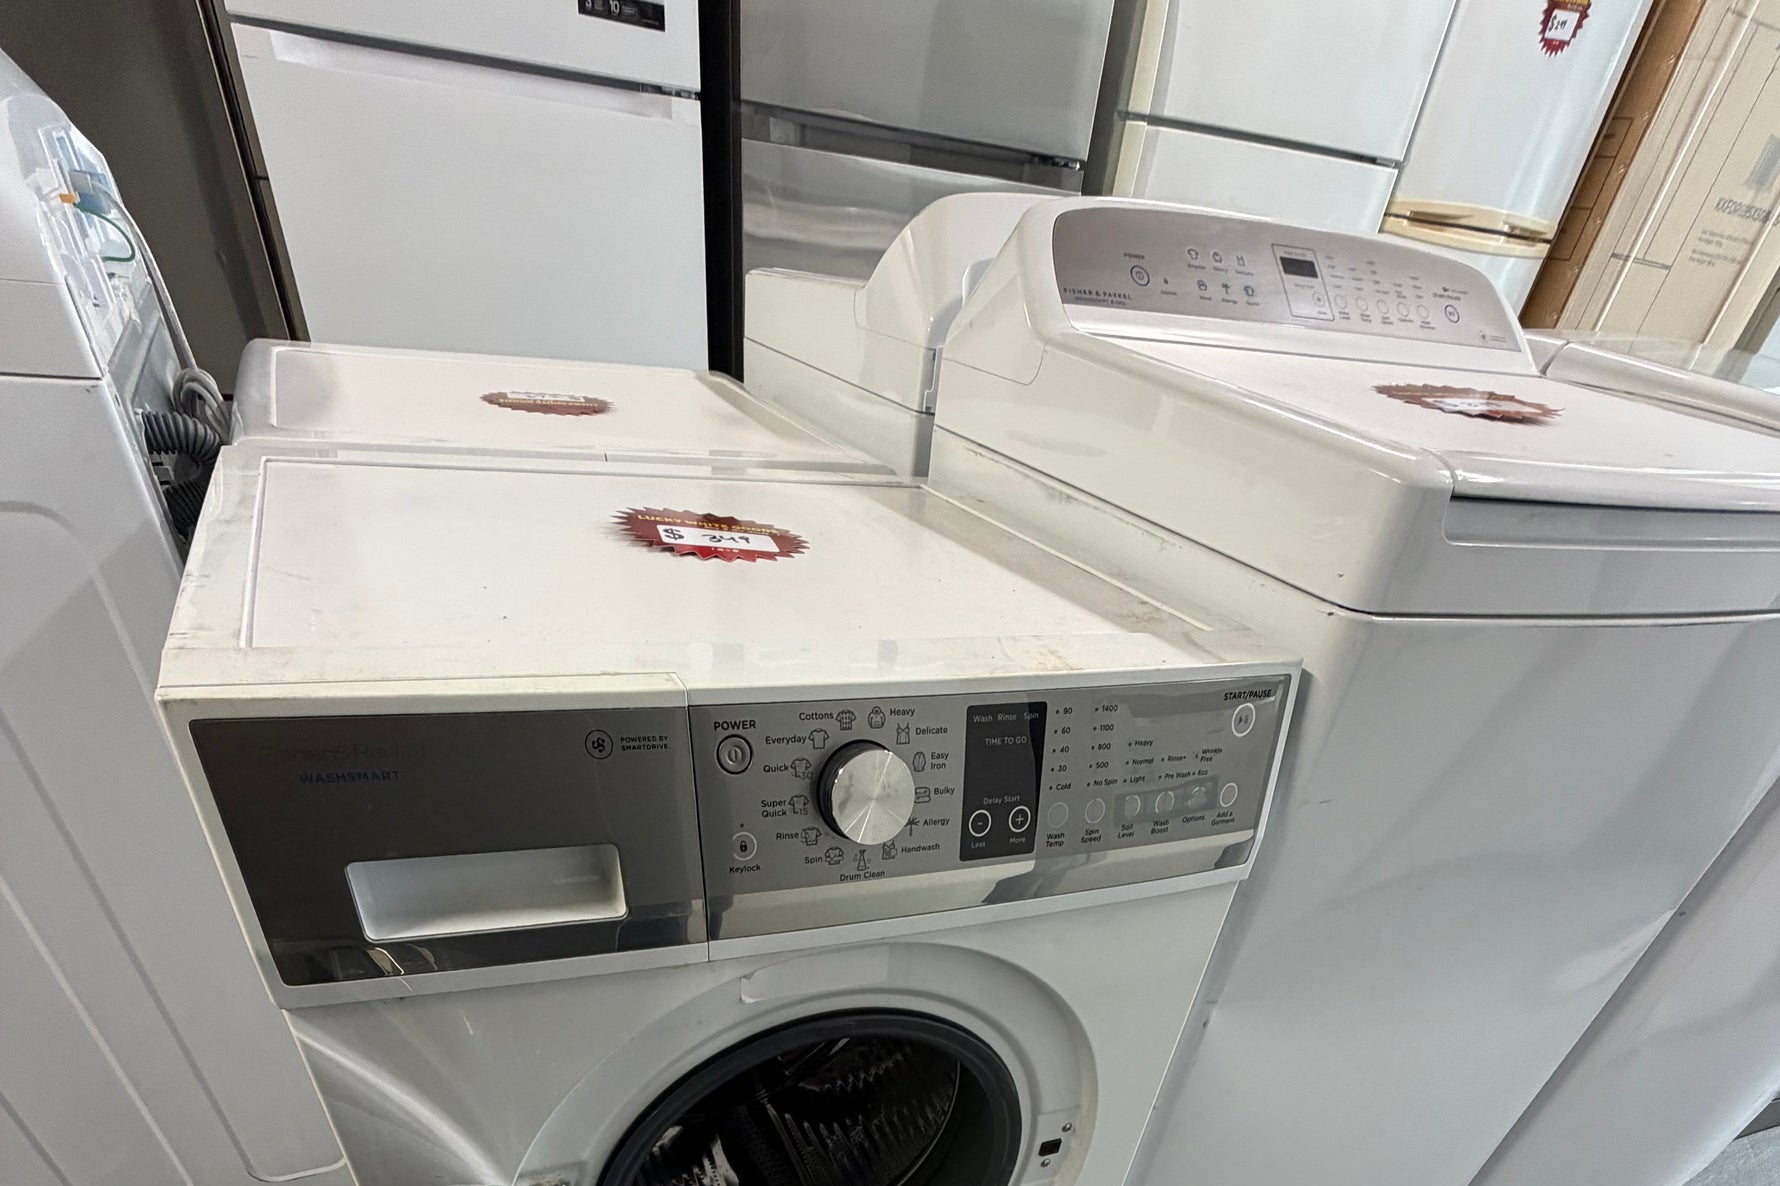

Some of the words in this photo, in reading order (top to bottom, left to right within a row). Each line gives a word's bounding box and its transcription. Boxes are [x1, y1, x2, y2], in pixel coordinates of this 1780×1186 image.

[638, 514, 681, 523] LUCKY
[663, 528, 684, 540] $
[1224, 690, 1272, 700] START/PAUSE
[799, 712, 834, 721] Cottons
[890, 708, 915, 717] Heavy
[973, 714, 992, 723] Wash
[998, 713, 1017, 722] Rinse
[1024, 712, 1039, 720] Spin
[714, 720, 756, 730] POWER
[915, 726, 948, 735] Delicate
[766, 735, 806, 745] Everyday
[985, 737, 1001, 746] TIME
[1004, 736, 1014, 745] TO
[1016, 736, 1027, 744] GO
[931, 752, 949, 762] Easy
[763, 764, 790, 773] Quick
[931, 762, 946, 770] Iron
[297, 770, 400, 784] WASHSMART
[934, 786, 955, 796] Bulky
[761, 800, 786, 808] Super
[983, 796, 1001, 805] Delay
[1004, 795, 1020, 803] Start
[762, 809, 787, 818] Quick
[922, 817, 950, 827] Allergy
[1182, 815, 1204, 823] Options
[1211, 817, 1235, 826] Garment
[1047, 832, 1065, 840] Wash
[1080, 835, 1101, 844] Speed
[901, 843, 940, 854] Handwash
[804, 856, 823, 864] Spin
[729, 864, 761, 873] Keylock
[840, 873, 862, 882] Drum
[864, 870, 885, 879] Clean
